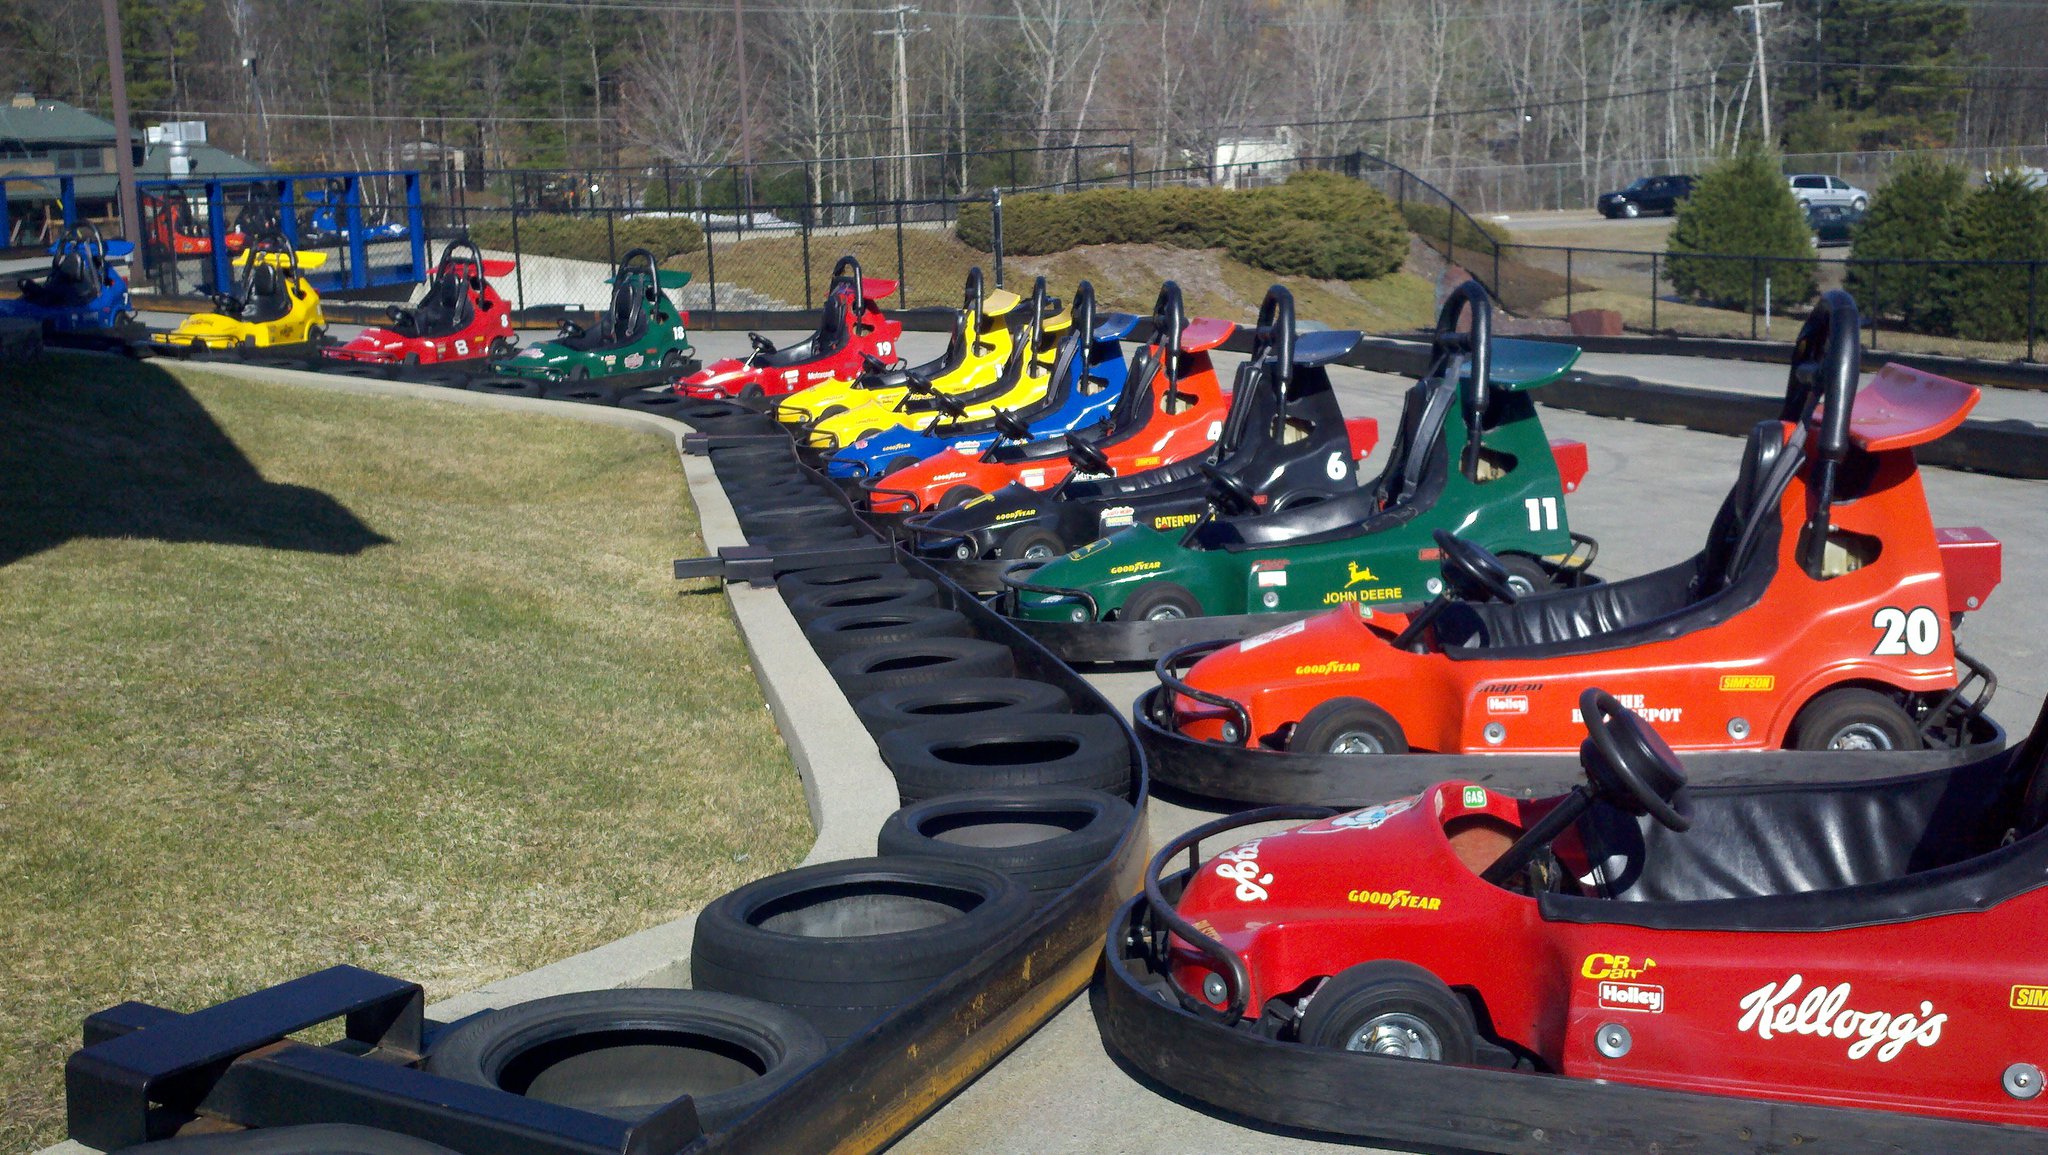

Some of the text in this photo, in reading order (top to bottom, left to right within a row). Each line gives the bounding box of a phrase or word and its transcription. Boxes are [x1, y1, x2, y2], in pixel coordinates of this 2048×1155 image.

[501, 313, 508, 328] 8
[673, 326, 685, 340] 18
[876, 341, 892, 356] 19
[1326, 452, 1347, 480] 6
[996, 509, 1036, 520] GOODYEAR
[1155, 513, 1216, 529] CATERPI
[1525, 497, 1558, 531] 11
[1111, 561, 1161, 574] GOODYEAR
[1323, 587, 1402, 604] JOHN DEERE
[1871, 606, 1940, 655] 20
[1296, 661, 1360, 675] GOODYEAR
[1723, 677, 1771, 689] SIMPSON
[1489, 698, 1526, 712] Holley
[1631, 708, 1683, 722] EPOT
[1465, 790, 1483, 804] GAS
[1349, 889, 1441, 910] GOODYEAR
[1602, 985, 1661, 1010] Holley
[1738, 974, 1948, 1062] Kellogg's
